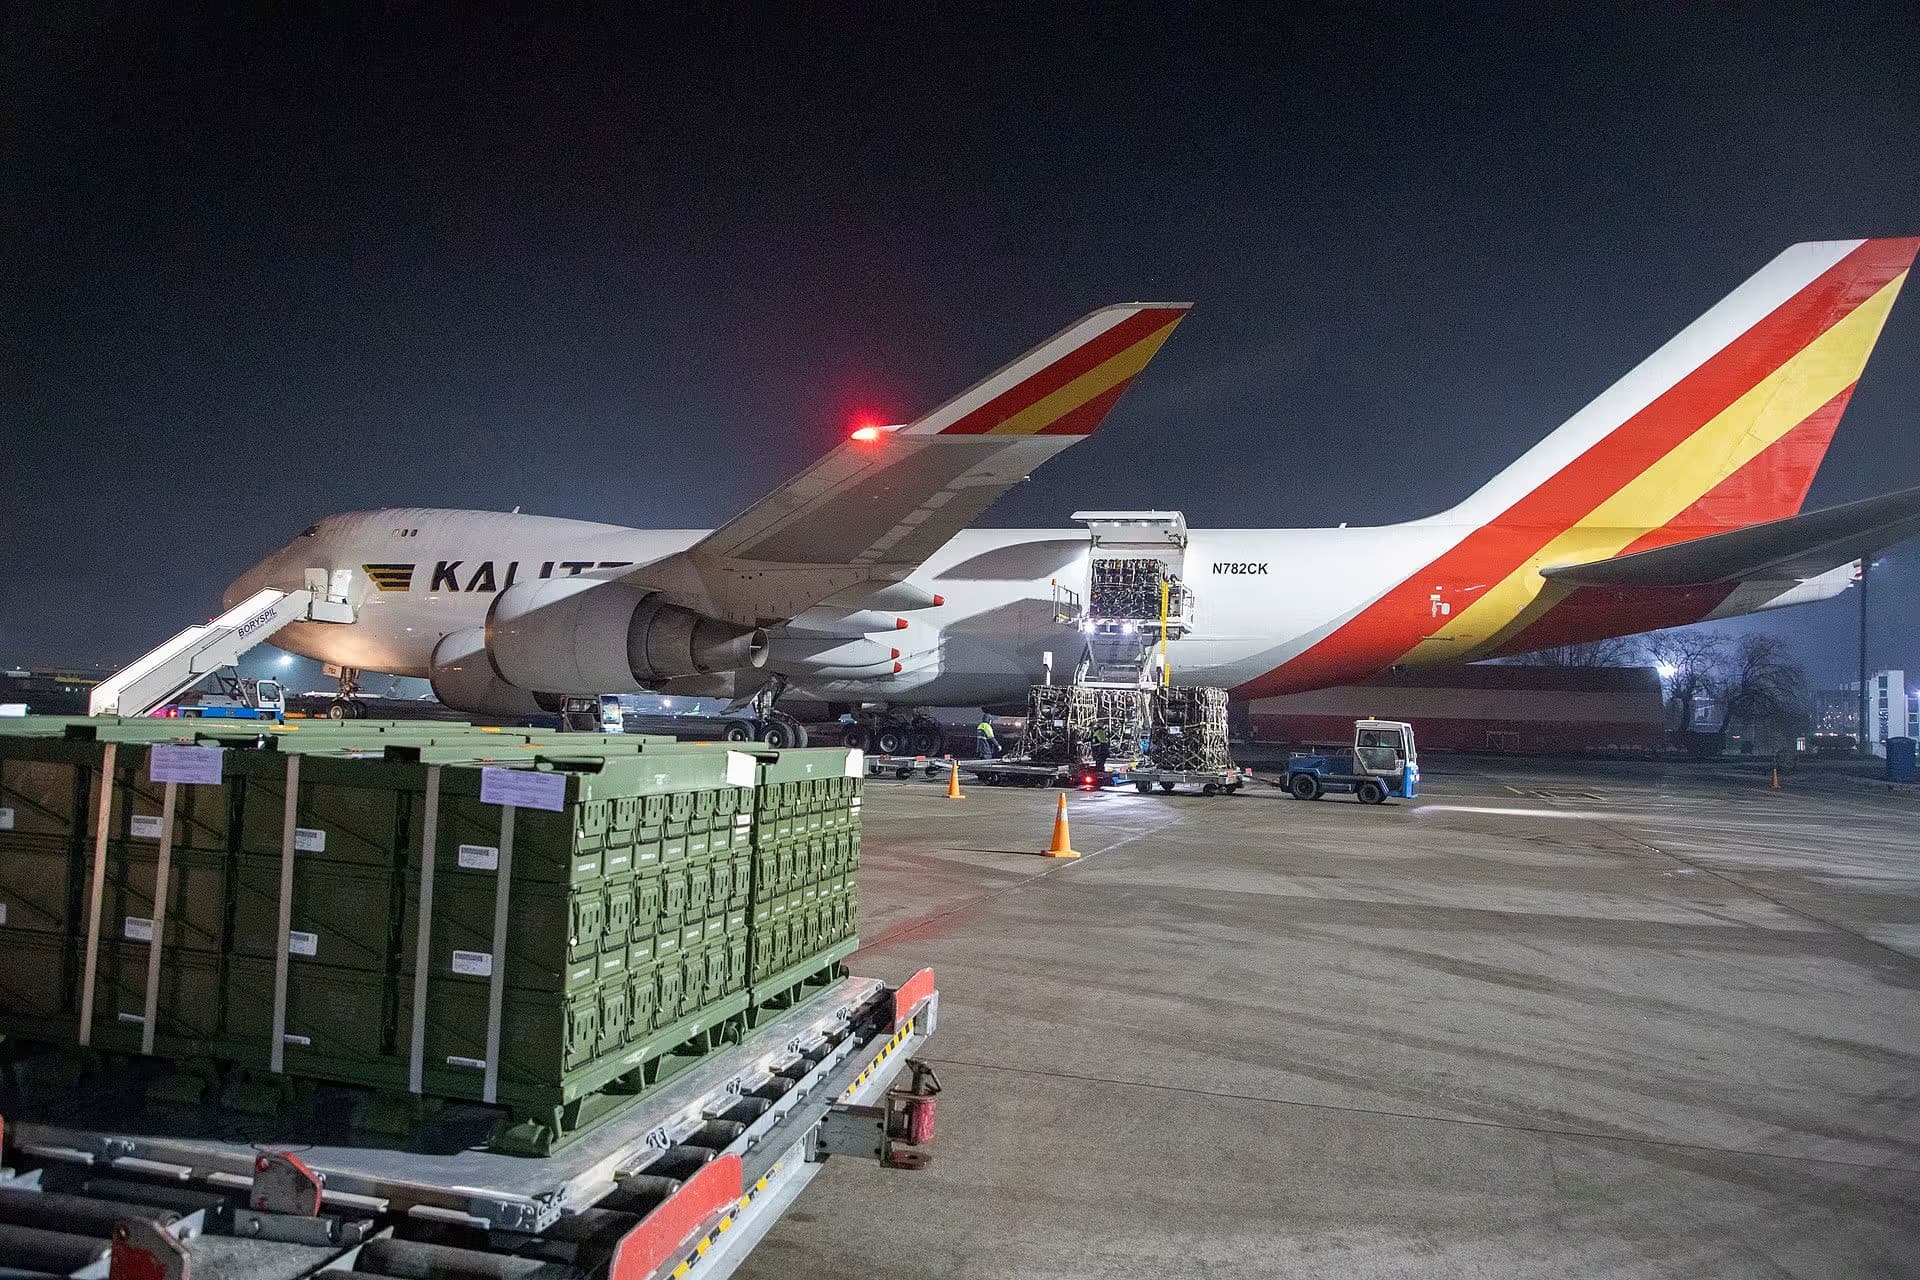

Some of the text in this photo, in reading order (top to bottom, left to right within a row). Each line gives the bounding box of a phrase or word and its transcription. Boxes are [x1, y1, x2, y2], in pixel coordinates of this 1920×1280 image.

[429, 560, 634, 593] KALIT
[1212, 562, 1268, 575] N782CK
[238, 607, 278, 637] BORYSPIL
